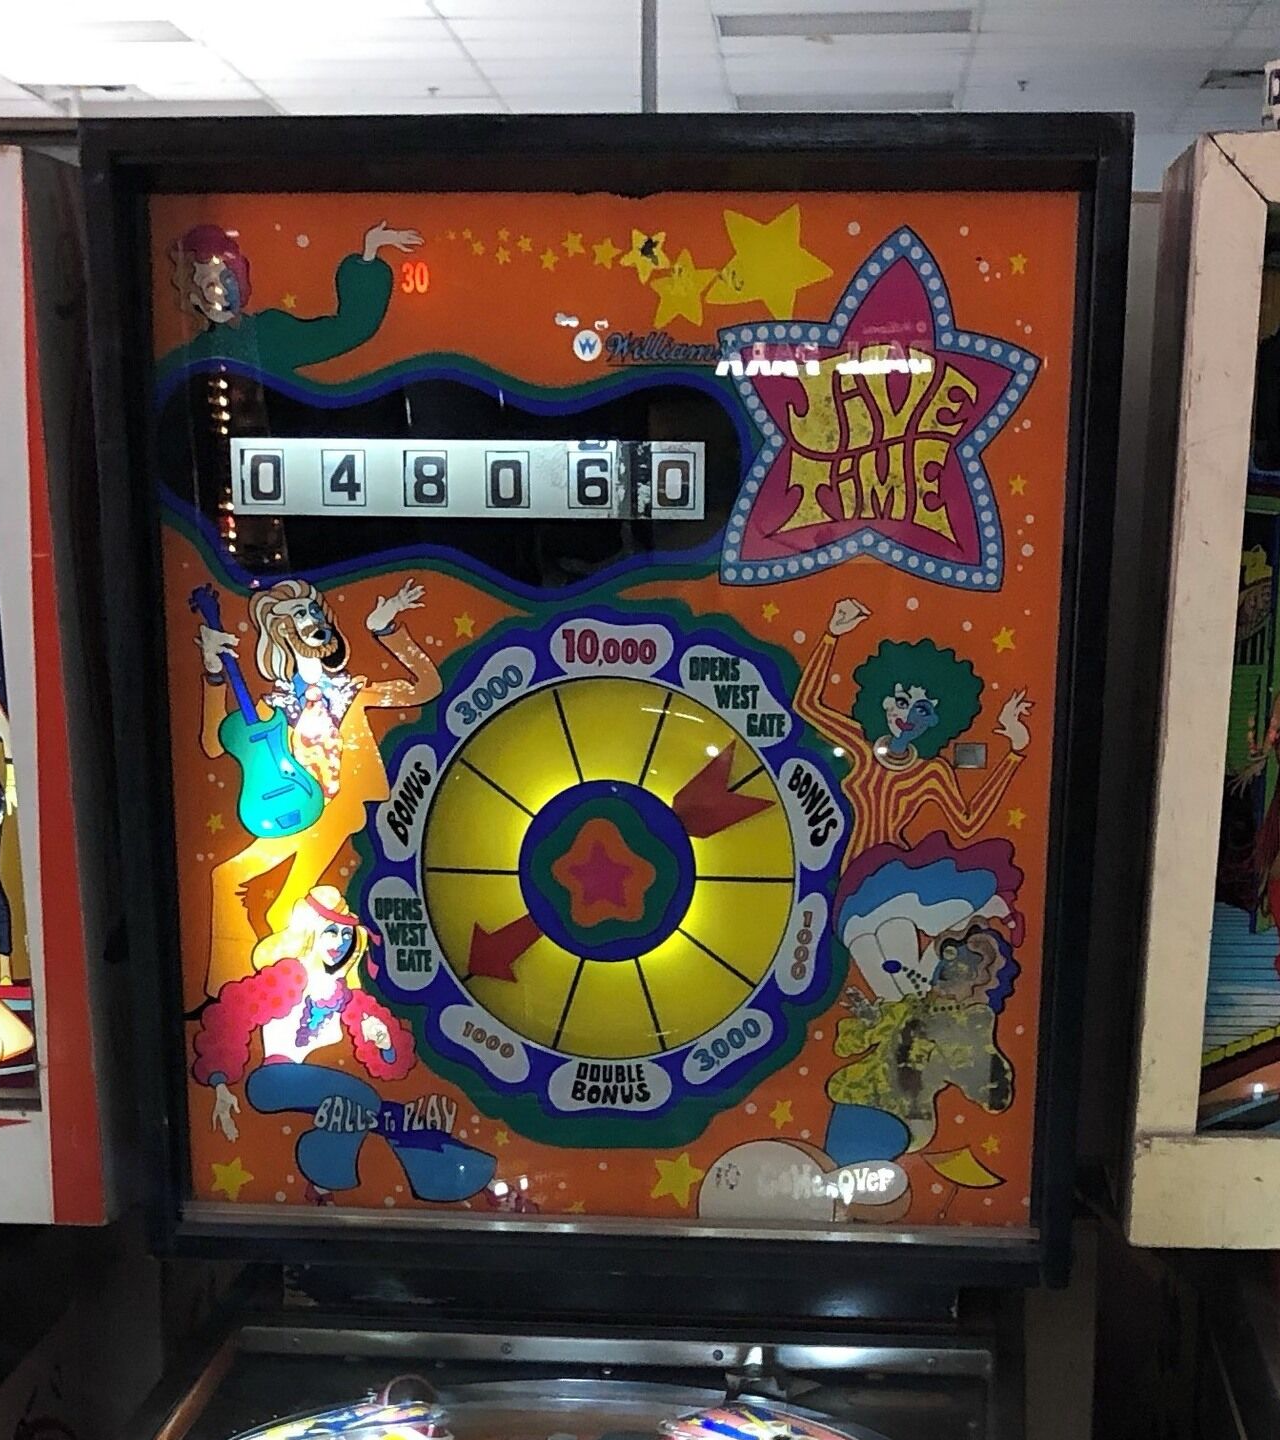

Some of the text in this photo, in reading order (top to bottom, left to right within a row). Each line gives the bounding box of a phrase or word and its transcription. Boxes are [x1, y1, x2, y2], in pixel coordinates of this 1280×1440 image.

[401, 262, 430, 294] 30
[562, 628, 657, 667] 10,000
[689, 656, 741, 681] OPENS
[714, 685, 760, 710] WEST
[746, 713, 786, 739] GATE
[389, 761, 432, 847] BONUS
[788, 764, 839, 848] BONUS
[374, 897, 423, 921] OPENS
[385, 924, 427, 947] WEST
[397, 948, 433, 972] GATE
[461, 1021, 515, 1059] 1000
[576, 1062, 645, 1083] DOUBLE
[571, 1080, 651, 1104] BONUS
[314, 1095, 381, 1134] BALLS
[403, 1096, 458, 1134] PLAY
